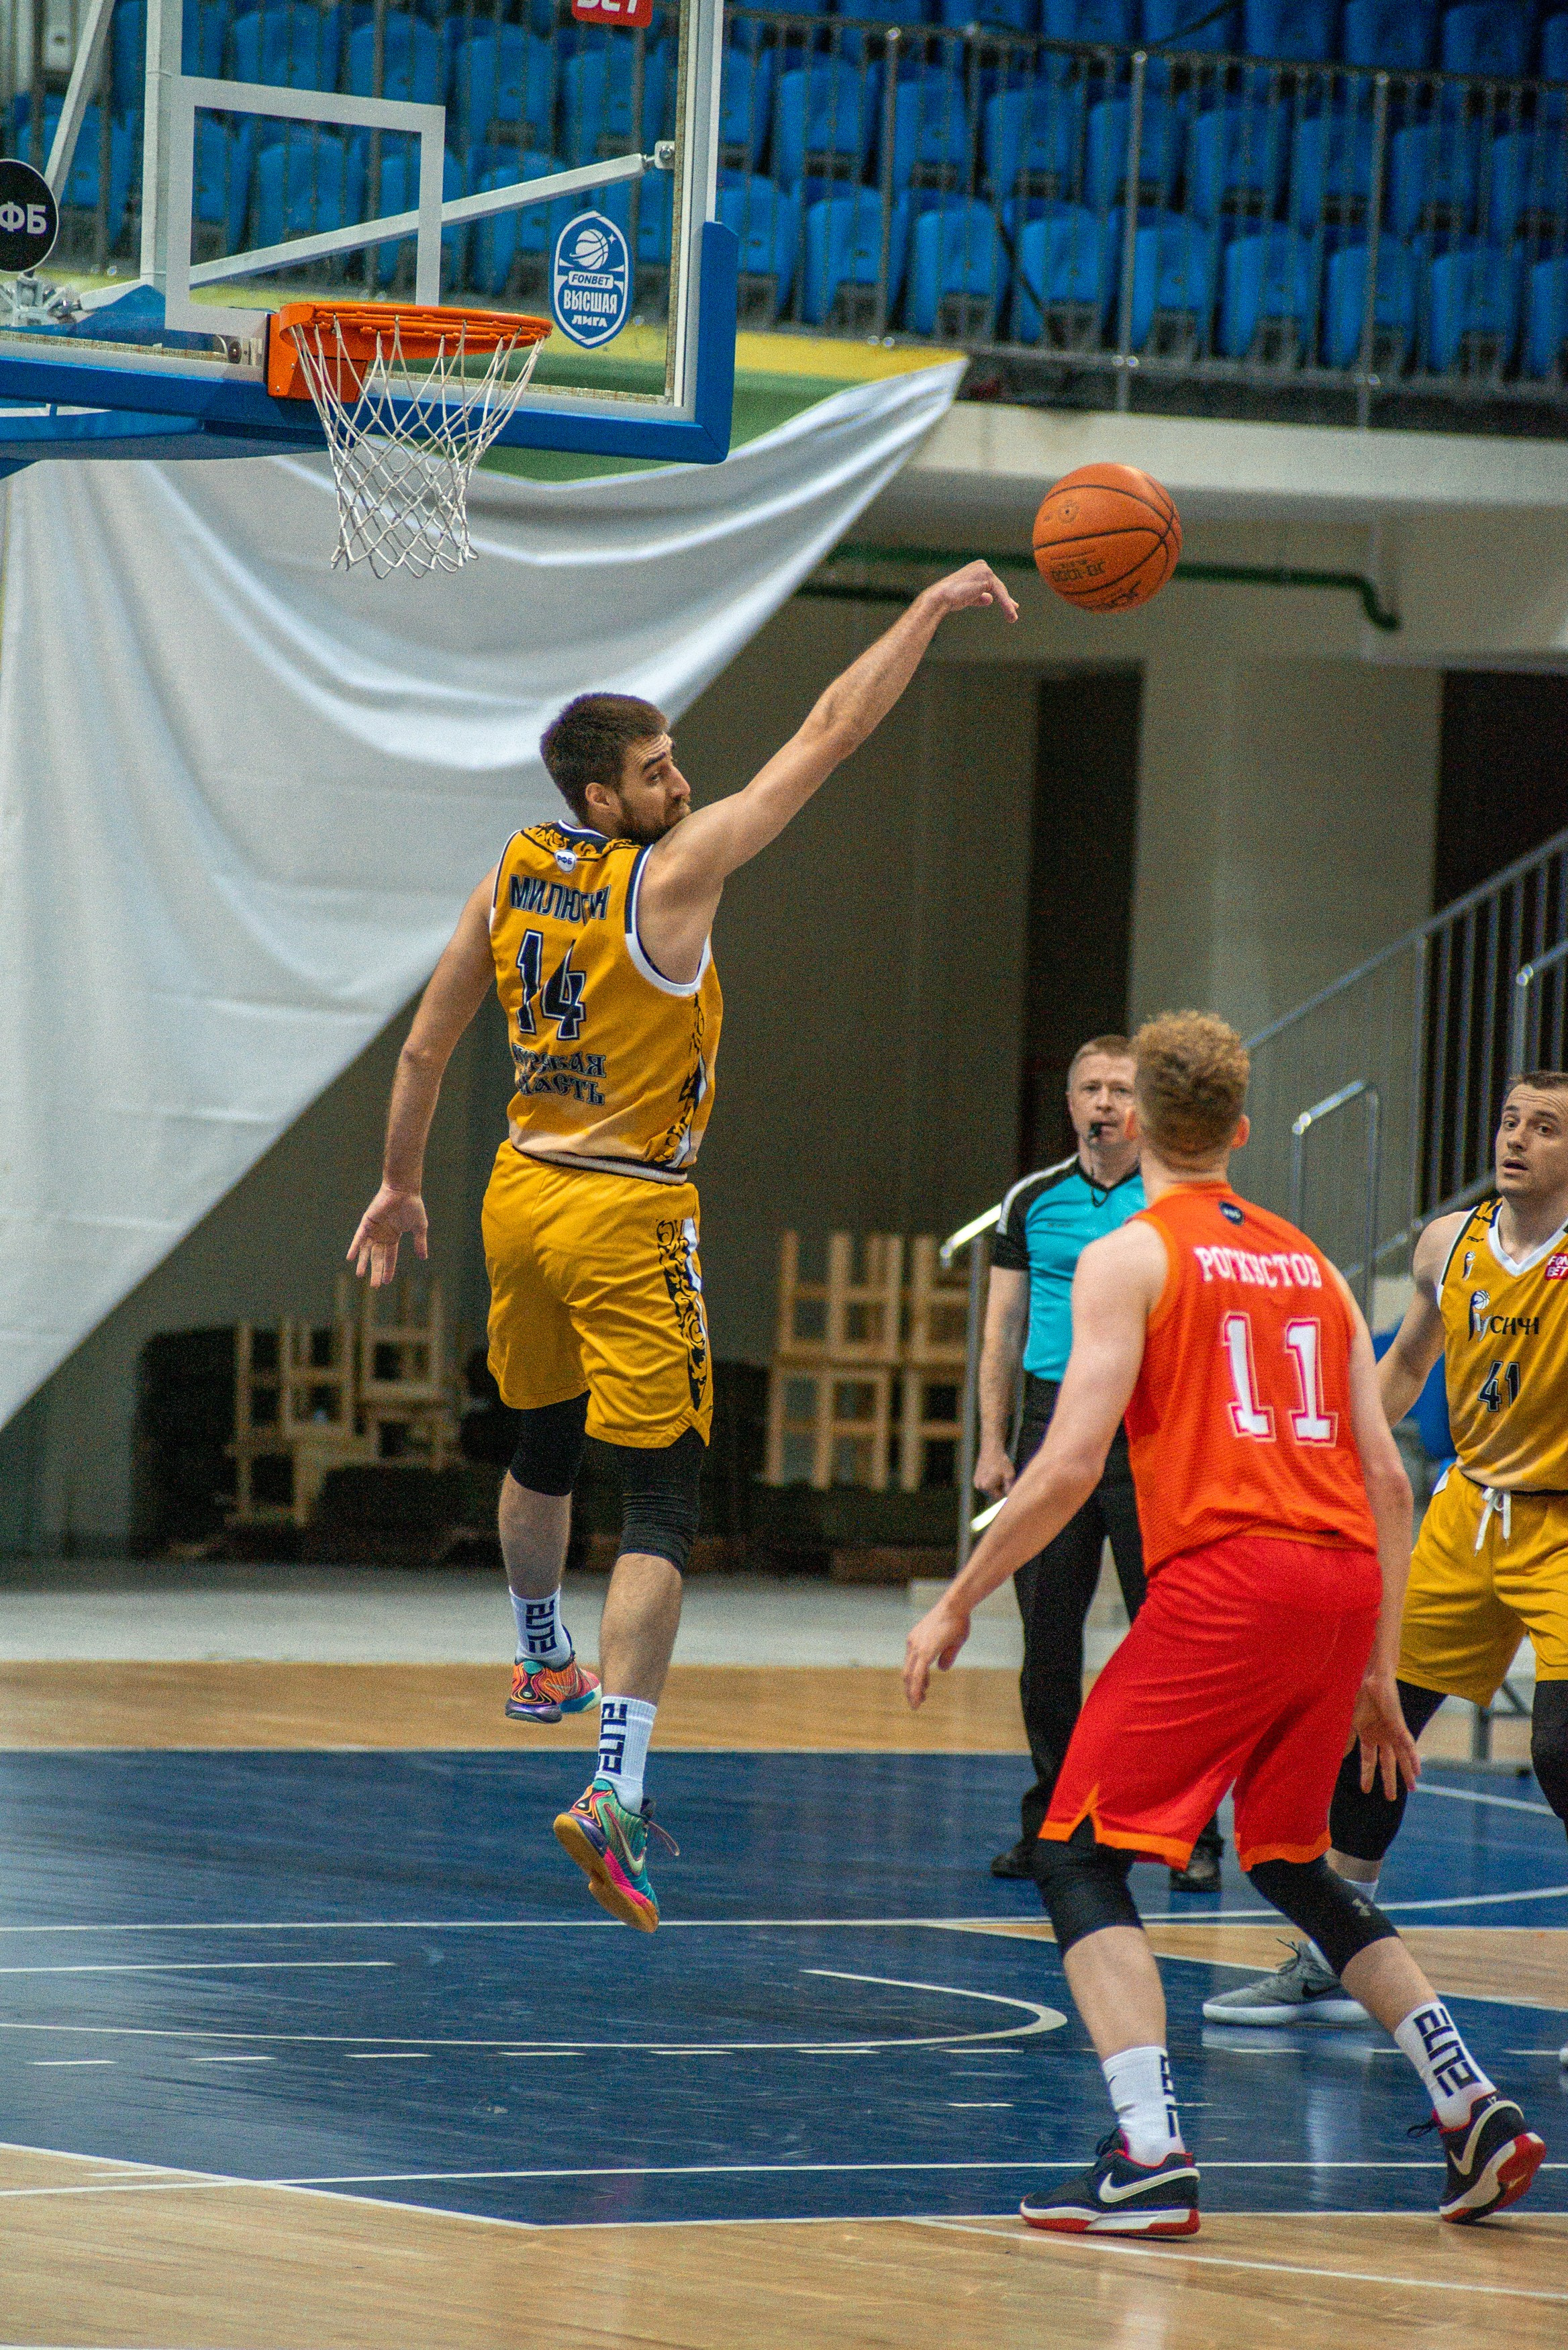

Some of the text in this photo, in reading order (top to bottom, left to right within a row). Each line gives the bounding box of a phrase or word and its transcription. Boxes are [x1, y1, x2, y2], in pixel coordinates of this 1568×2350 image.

[571, 274, 610, 286] FONBET
[563, 289, 618, 314] ВЫСШАЯ
[572, 315, 607, 328] ЛИГА
[557, 855, 573, 865] РФБ
[516, 929, 587, 1040] 14
[1547, 1266, 1568, 1277] BET
[1221, 1310, 1338, 1447] 11
[1478, 1360, 1520, 1412] 41
